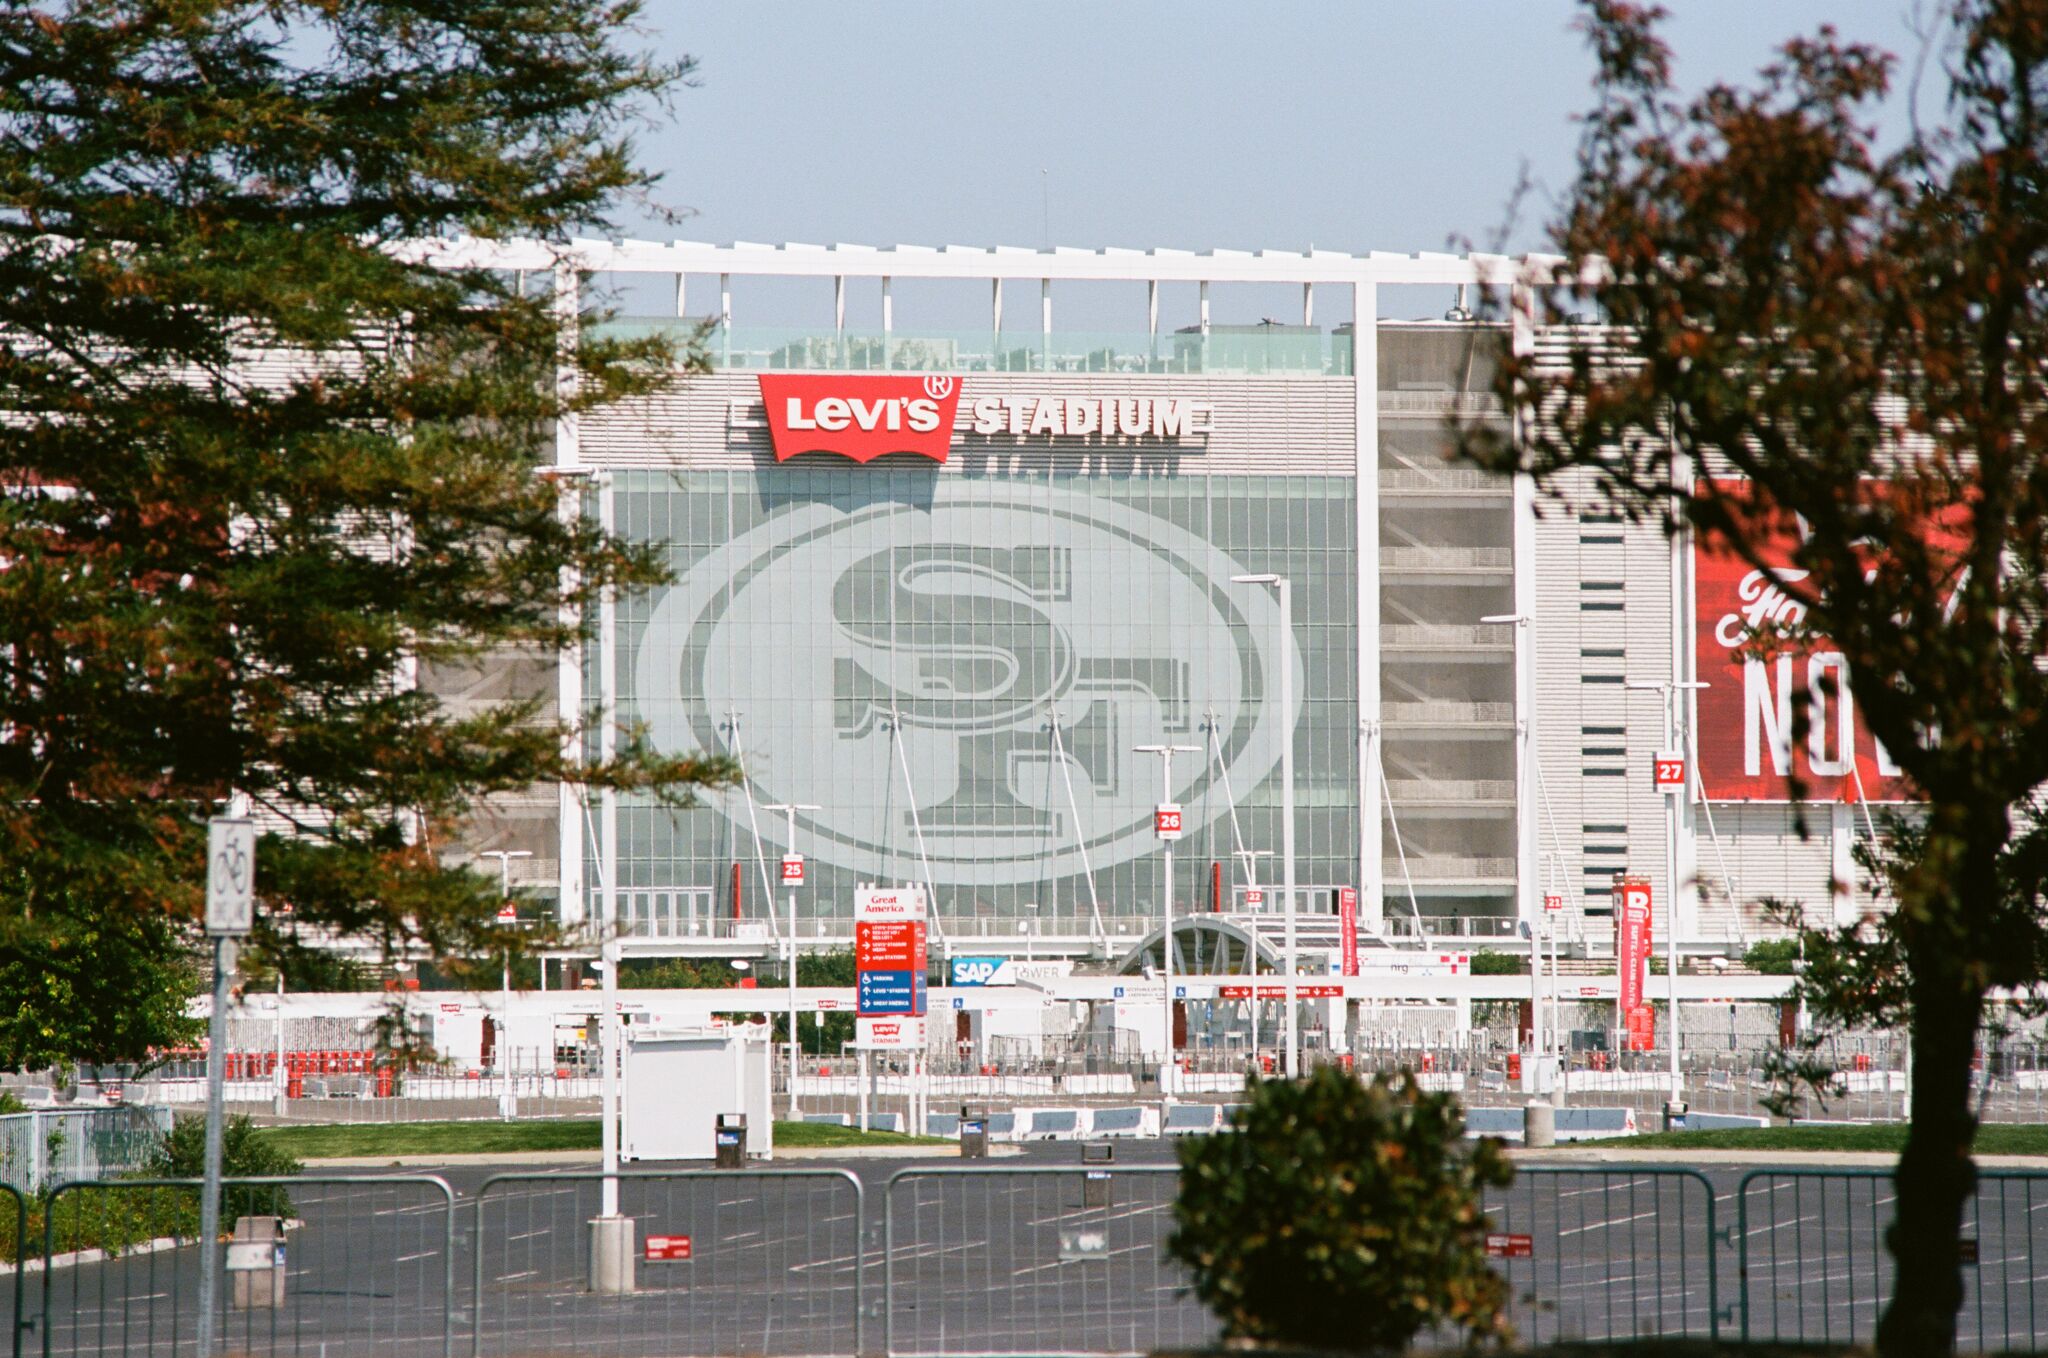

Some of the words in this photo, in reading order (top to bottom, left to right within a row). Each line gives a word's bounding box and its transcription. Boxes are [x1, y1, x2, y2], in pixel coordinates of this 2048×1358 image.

[973, 397, 1195, 436] STADIUM
[1660, 764, 1682, 779] 27
[1161, 815, 1179, 828] 26
[785, 864, 801, 875] 25
[871, 896, 897, 904] Great
[1249, 892, 1262, 901] 22
[1548, 898, 1561, 907] 21
[865, 905, 904, 913] America
[954, 962, 994, 982] SAP
[1011, 966, 1059, 978] TOWER
[1390, 964, 1408, 974] nrg
